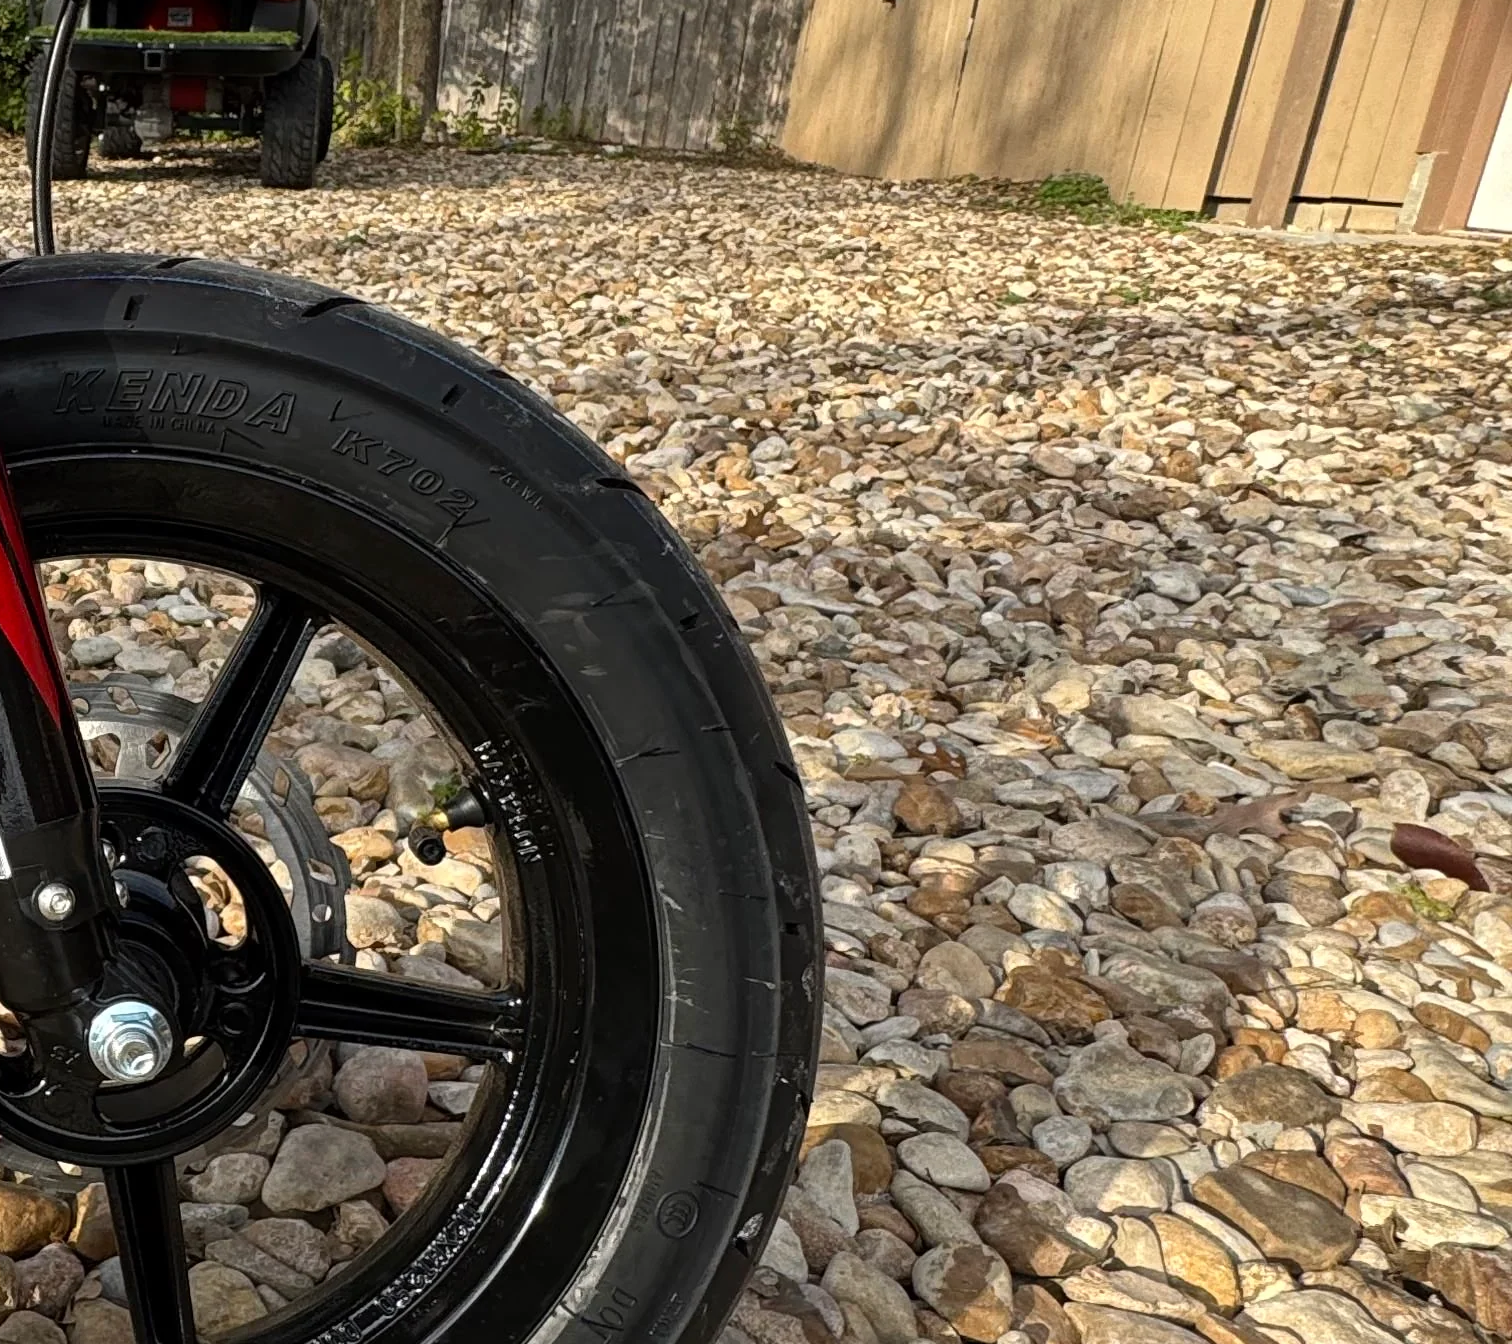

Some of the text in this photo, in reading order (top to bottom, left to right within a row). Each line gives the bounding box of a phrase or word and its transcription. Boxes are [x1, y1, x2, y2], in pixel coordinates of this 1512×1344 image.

[55, 369, 296, 437] KENDA
[148, 415, 165, 430] IN
[330, 426, 478, 520] K702
